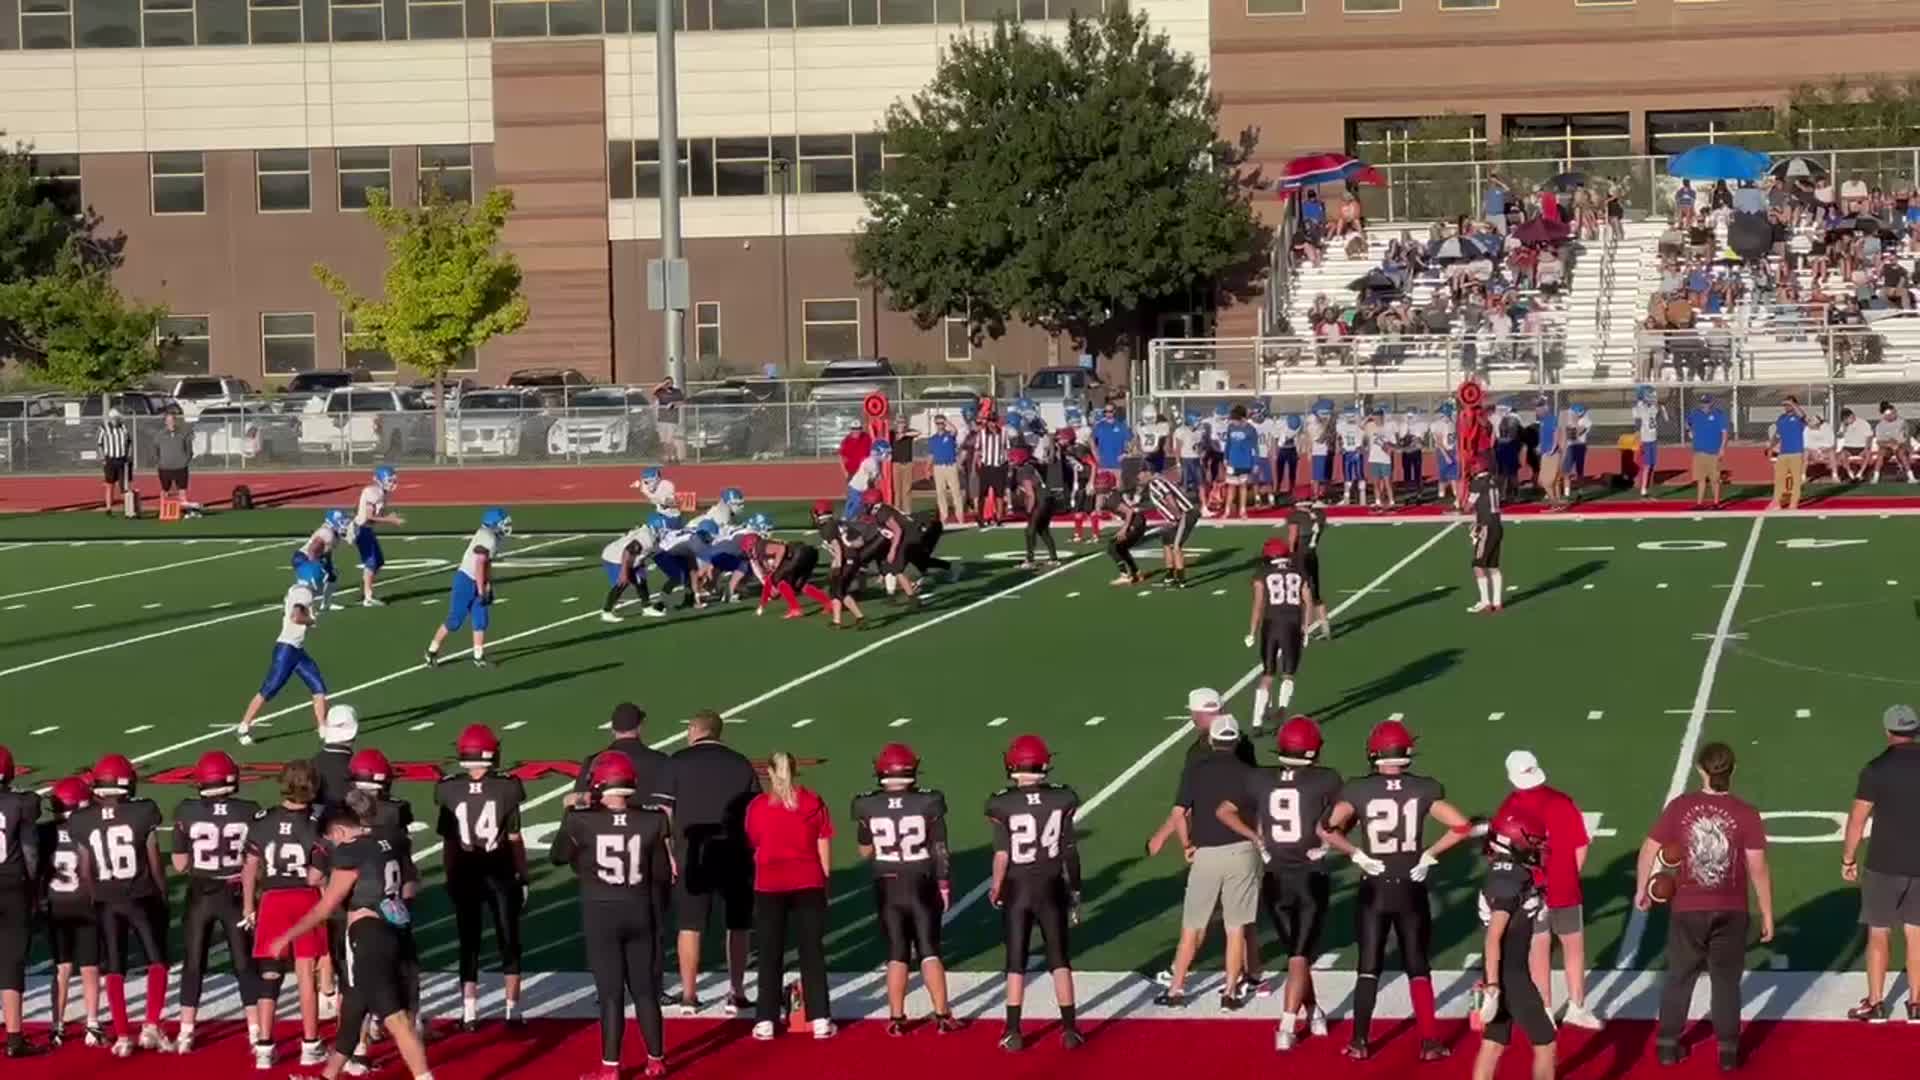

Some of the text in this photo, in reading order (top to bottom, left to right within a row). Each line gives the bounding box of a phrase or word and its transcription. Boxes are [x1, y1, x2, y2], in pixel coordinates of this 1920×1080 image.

[1266, 573, 1302, 605] 88
[469, 782, 482, 794] H
[887, 797, 903, 809] H
[1026, 793, 1042, 805] H
[101, 807, 115, 820] H
[213, 803, 228, 816] H
[454, 800, 499, 852] 14
[613, 813, 628, 826] H
[1269, 788, 1302, 843] 9
[1366, 798, 1418, 854] 21
[189, 821, 249, 870] 23
[279, 822, 293, 835] H
[869, 815, 929, 862] 22
[1009, 809, 1062, 863] 24
[88, 824, 137, 881] 16
[264, 842, 307, 878] 13
[596, 834, 643, 885] 51
